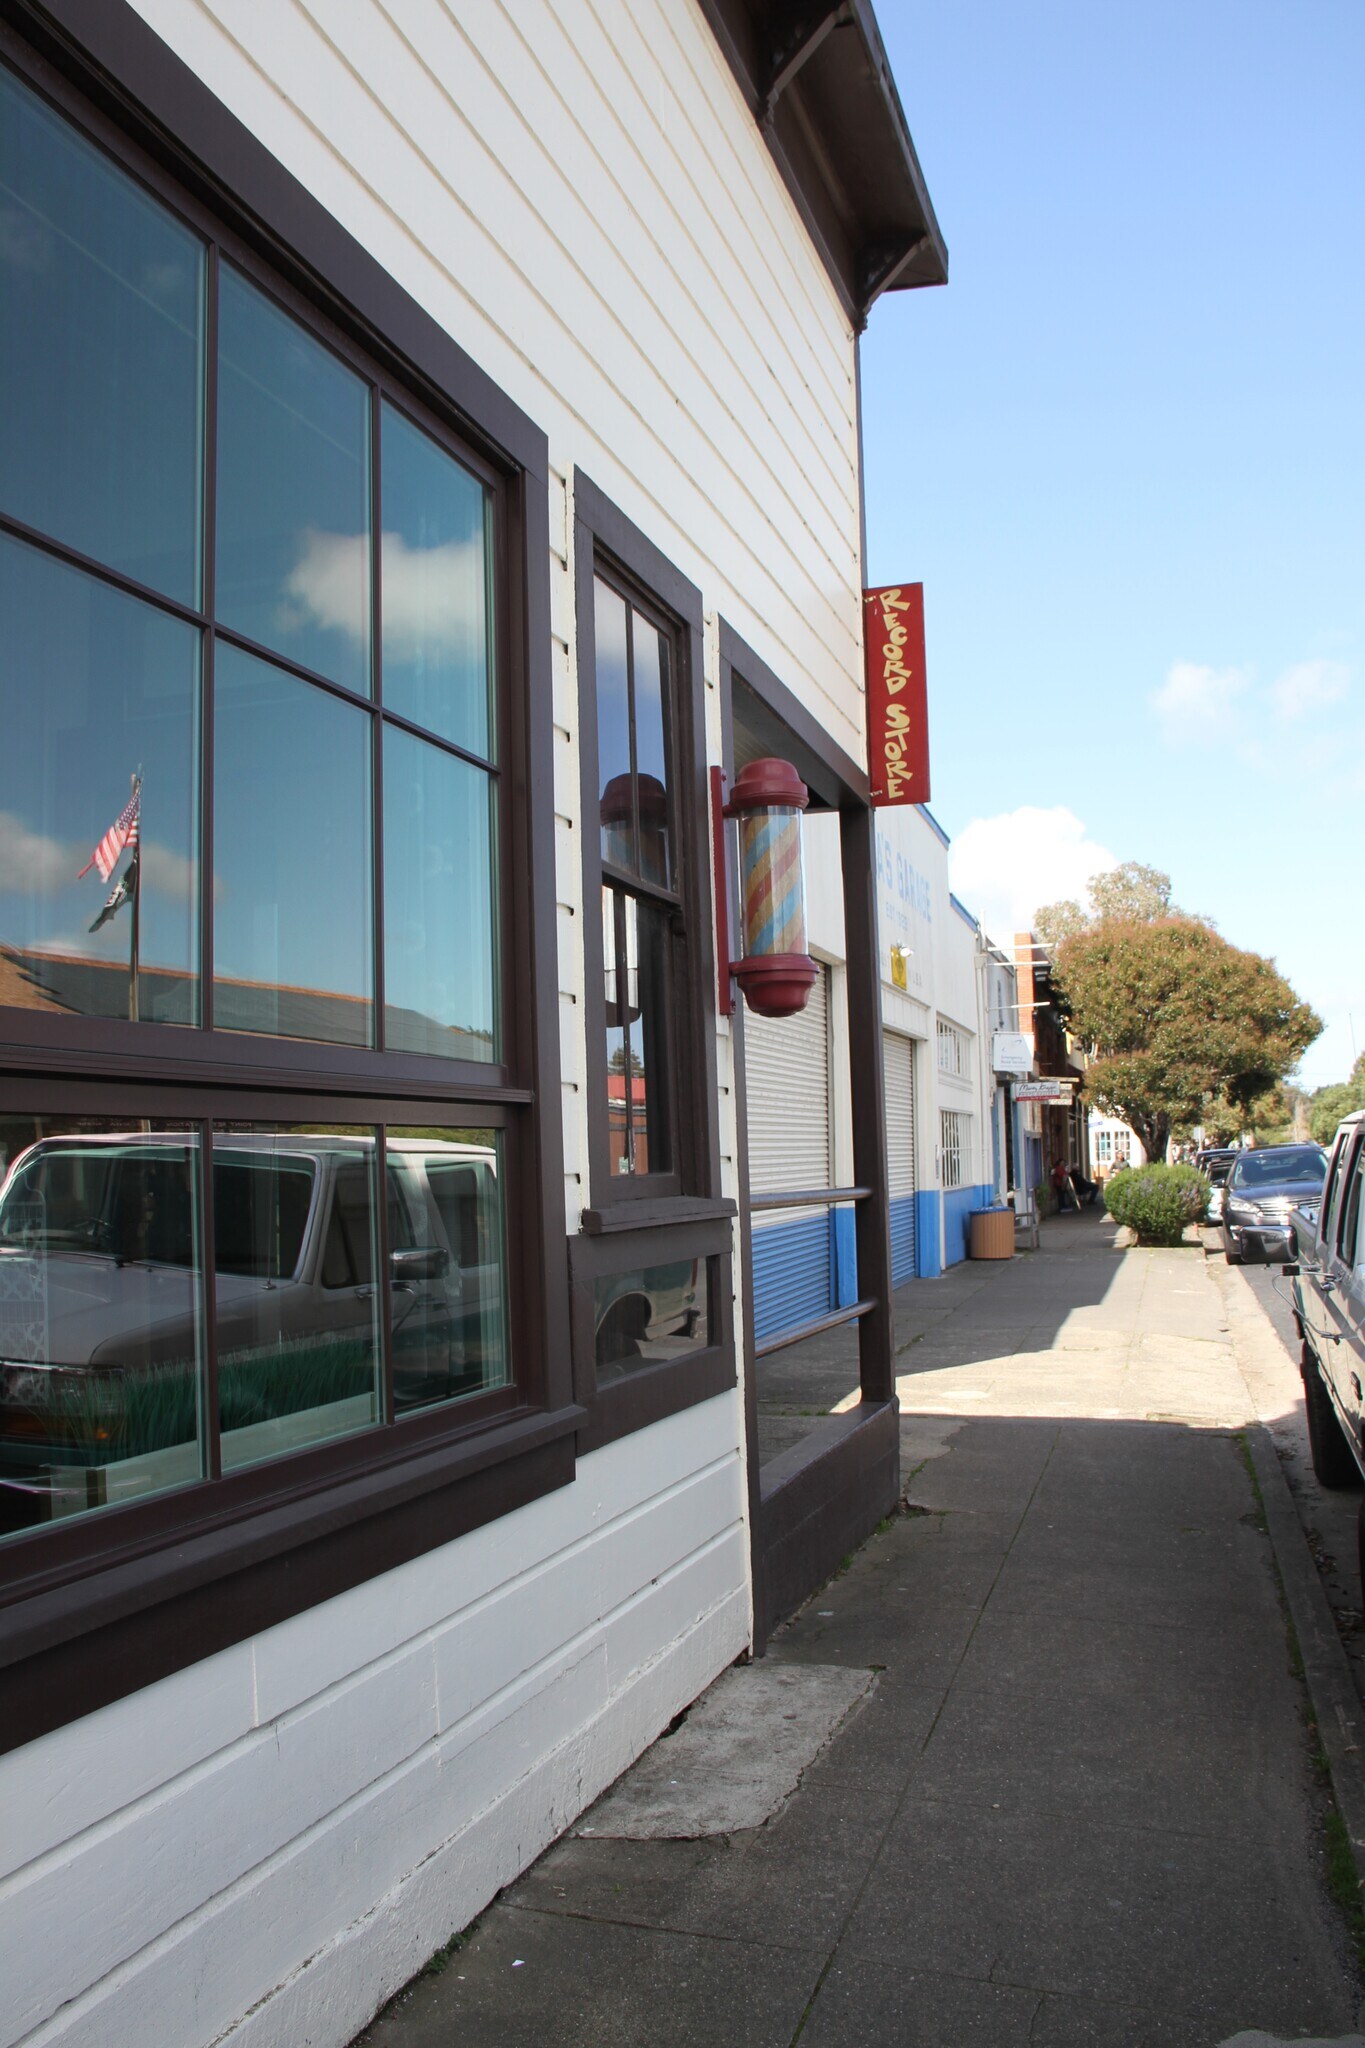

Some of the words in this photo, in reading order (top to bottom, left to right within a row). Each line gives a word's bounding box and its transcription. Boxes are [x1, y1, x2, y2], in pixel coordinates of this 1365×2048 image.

[880, 588, 913, 695] RECORD
[884, 704, 913, 799] STORE
[896, 851, 932, 924] GARAGE
